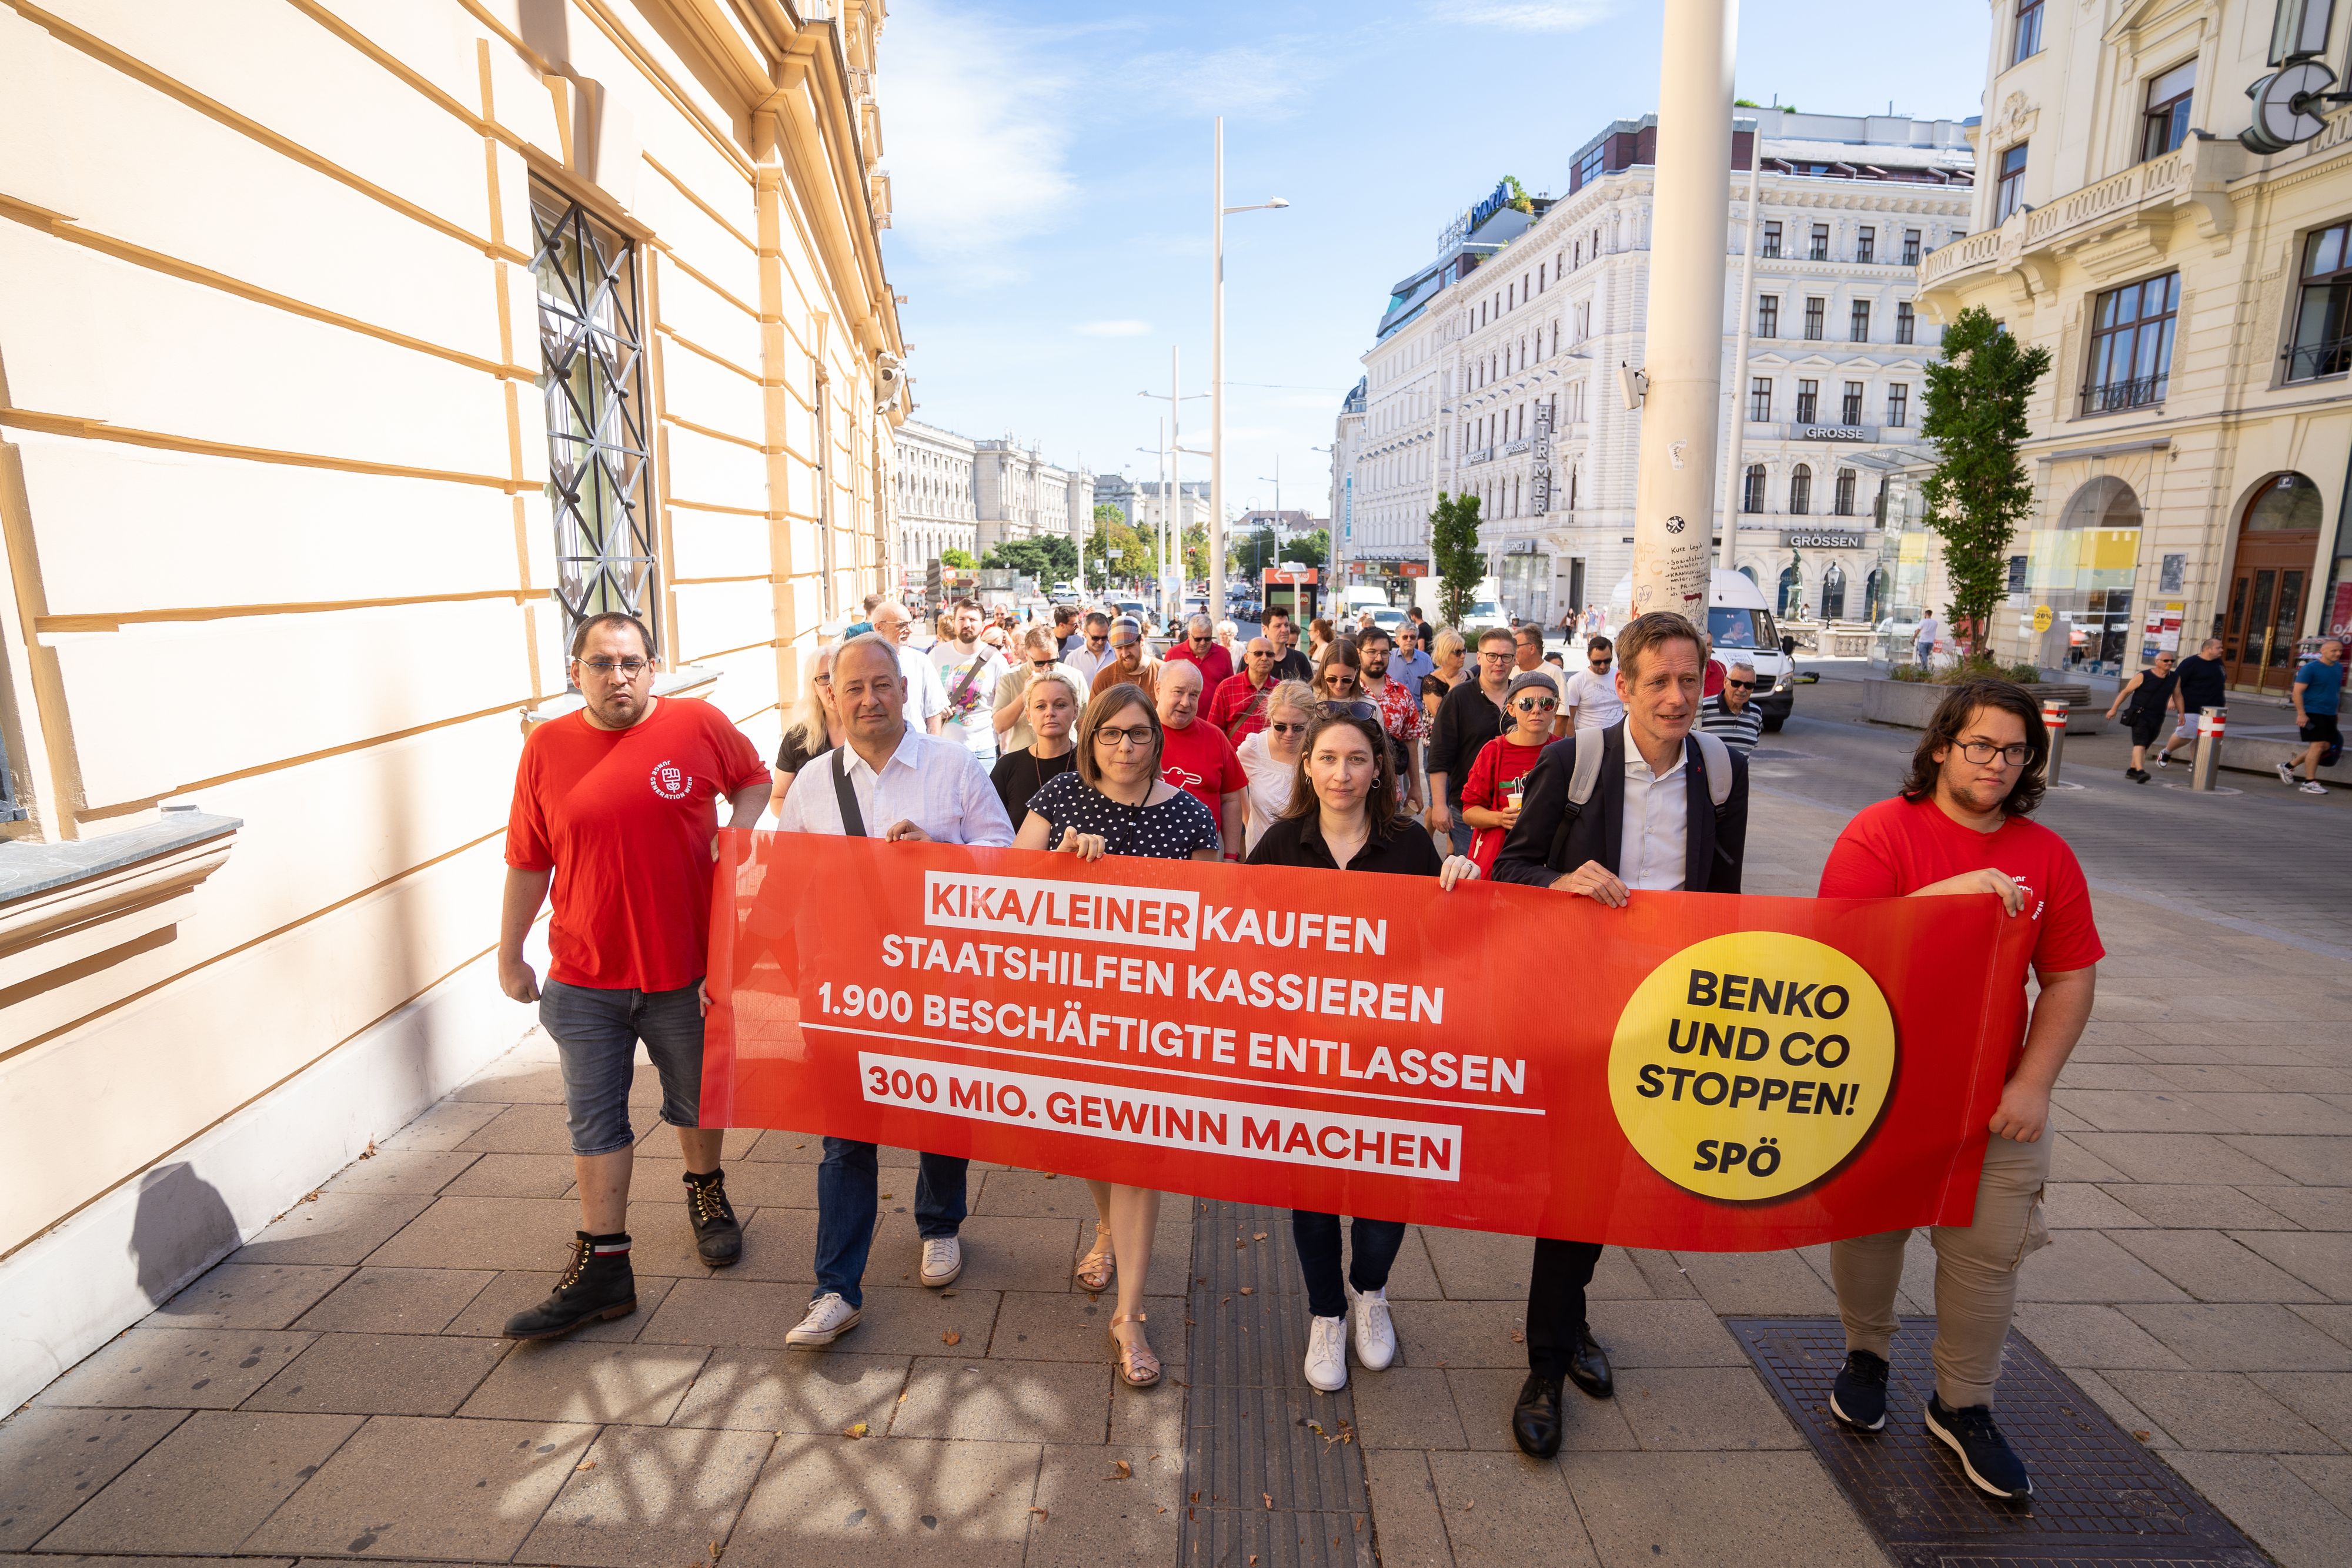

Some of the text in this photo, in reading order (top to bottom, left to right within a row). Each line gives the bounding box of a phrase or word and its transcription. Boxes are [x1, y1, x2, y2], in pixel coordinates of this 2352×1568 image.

[1806, 427, 1864, 439] GROSSE
[1534, 406, 1550, 516] HIRMER
[1790, 534, 1859, 547] GRÖSSEN
[650, 760, 693, 800] JUNGE GENERATION WIEN
[931, 882, 1387, 955] KIKA/LEINER KAUFEN
[2032, 901, 2044, 921] WIEN
[881, 934, 1444, 1024] STAATSHILFEN KASSIEREN
[1687, 969, 1850, 1020] BENKO
[818, 981, 1525, 1094] 1.900 BESCHÄFTIGTE ENTLASSEN
[1668, 1018, 1850, 1069] UND CO
[1636, 1064, 1860, 1116] STOPPEN!
[868, 1065, 1451, 1171] 300 MIO. GEWINN MACHEN
[1693, 1136, 1781, 1178] SPÖ
